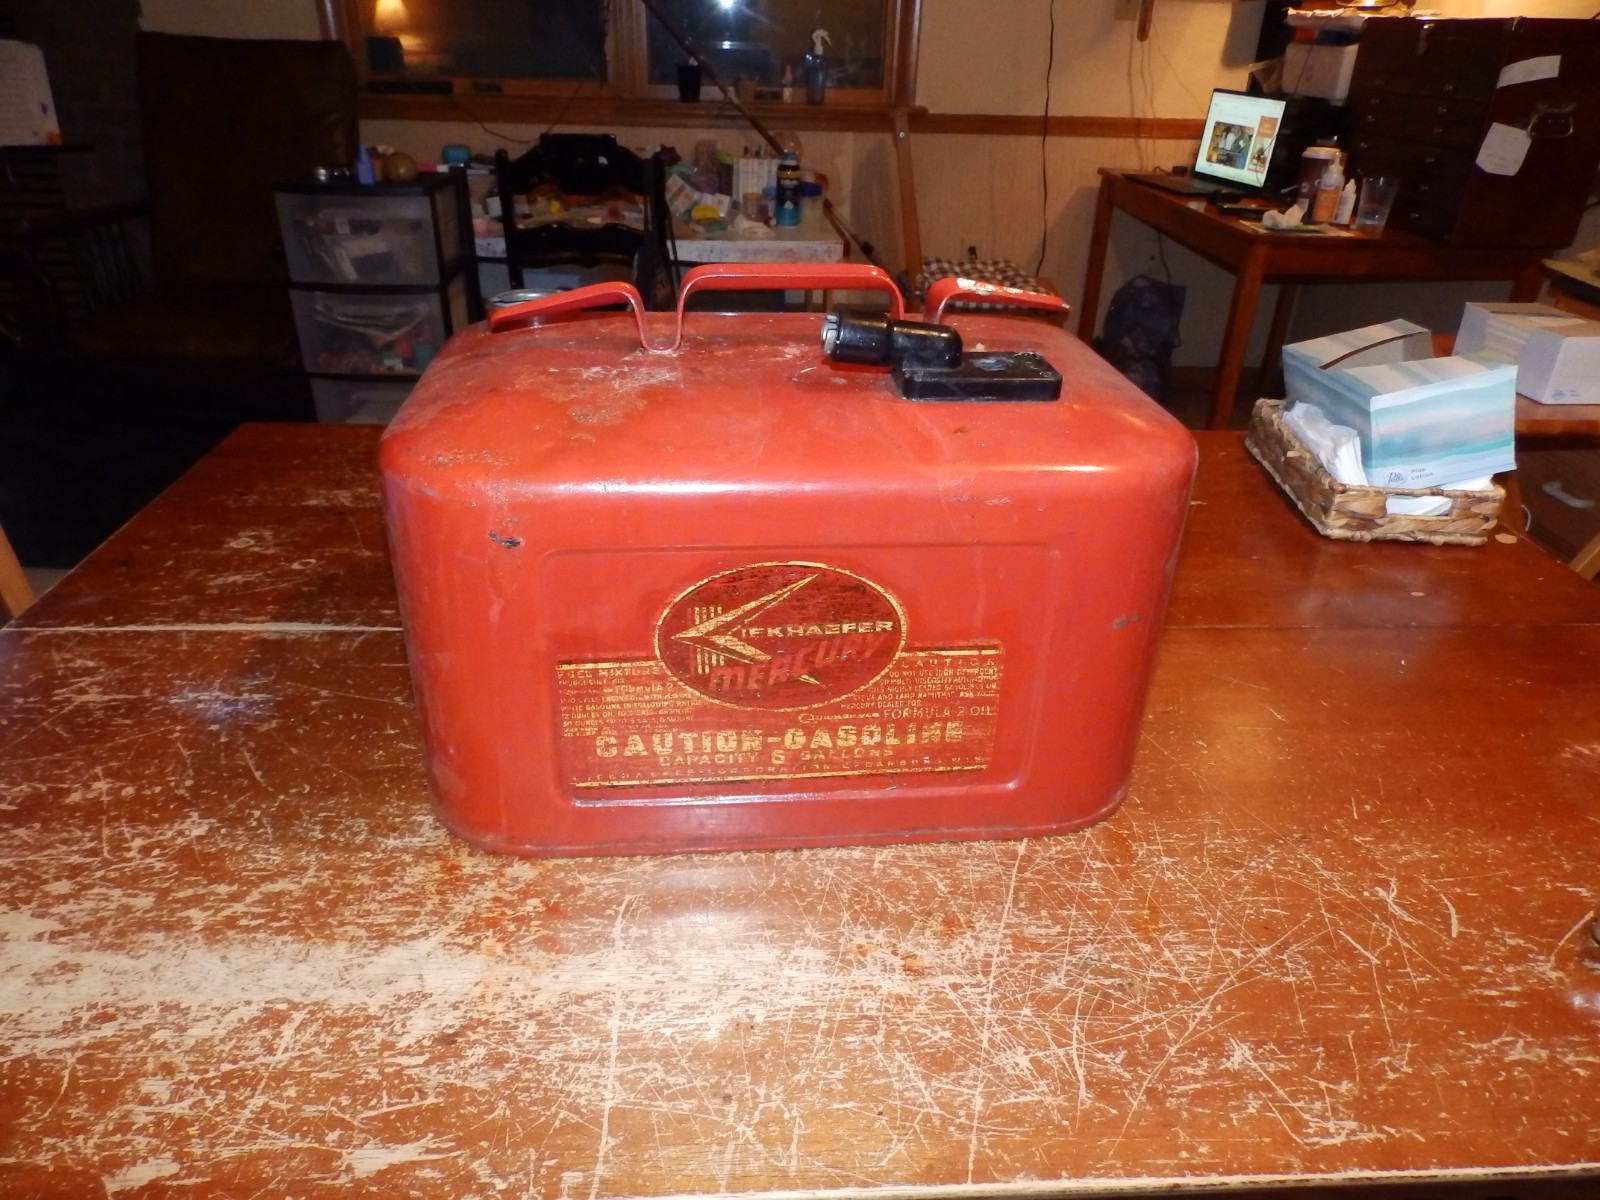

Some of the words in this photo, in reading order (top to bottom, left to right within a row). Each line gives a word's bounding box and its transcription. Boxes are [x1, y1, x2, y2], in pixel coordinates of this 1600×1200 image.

[1411, 472, 1434, 481] Lotion
[889, 670, 900, 678] DO
[585, 702, 620, 711] GASOLINE
[633, 699, 674, 709] FOLLOWING
[877, 700, 904, 709] DEALER
[883, 705, 950, 721] FORMULA
[659, 751, 760, 767] CAPACITY
